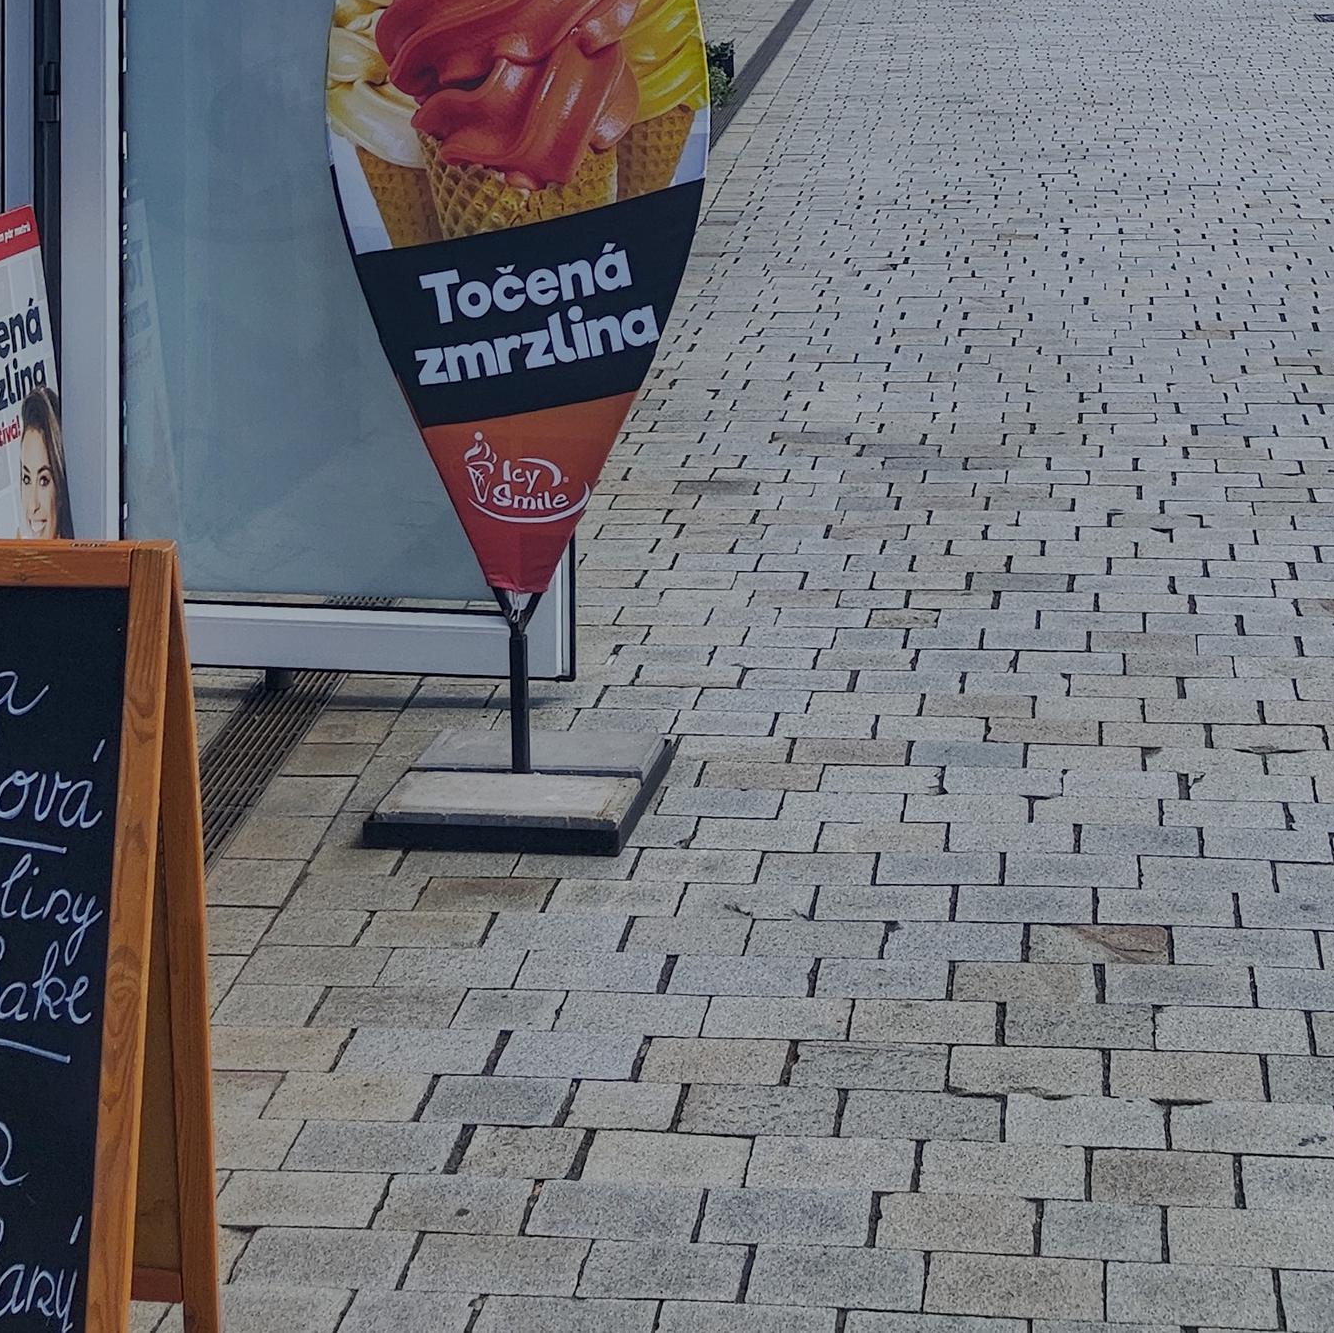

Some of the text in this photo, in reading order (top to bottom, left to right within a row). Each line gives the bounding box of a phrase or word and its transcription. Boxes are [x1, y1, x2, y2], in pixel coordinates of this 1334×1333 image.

[418, 242, 633, 325] Točená
[414, 305, 661, 386] zmrzlina
[492, 482, 570, 511] Smile
[503, 459, 539, 494] Icy
